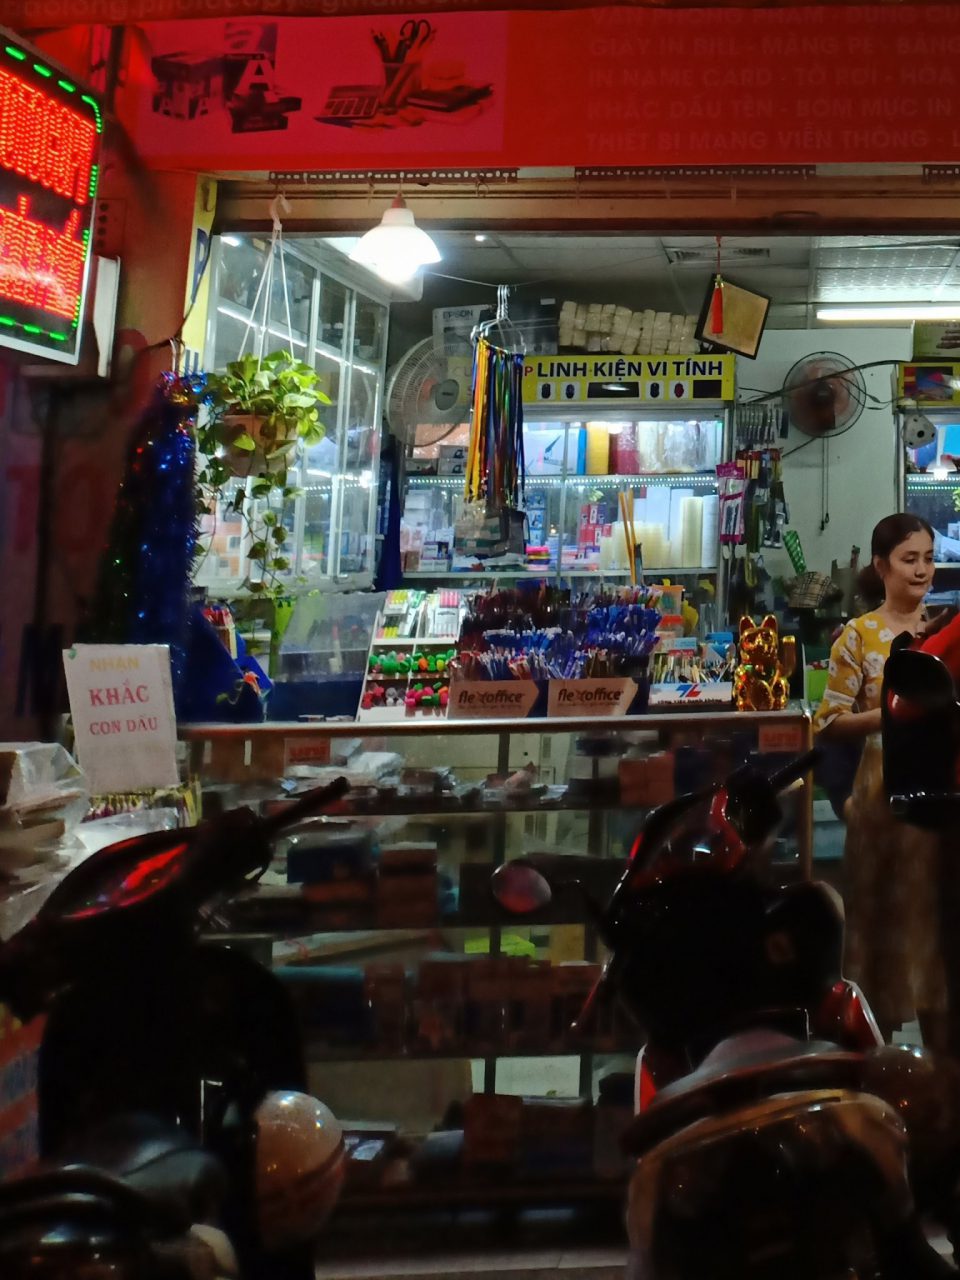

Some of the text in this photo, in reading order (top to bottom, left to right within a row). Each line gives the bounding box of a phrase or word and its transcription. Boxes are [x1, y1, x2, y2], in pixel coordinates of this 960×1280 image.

[621, 67, 694, 86] NAME
[702, 67, 773, 86] CARD
[926, 97, 952, 117] IN
[586, 123, 650, 152] THIẾT
[688, 130, 769, 157] MẠNG
[777, 119, 834, 150] VIỄN
[840, 122, 930, 150] THÔNG
[536, 362, 588, 378] LINH
[593, 358, 642, 382] KIỆN
[646, 361, 668, 378] VI
[672, 357, 723, 377] TÍNH
[88, 677, 151, 707] KHẮC
[89, 714, 159, 736] CON DẤU
